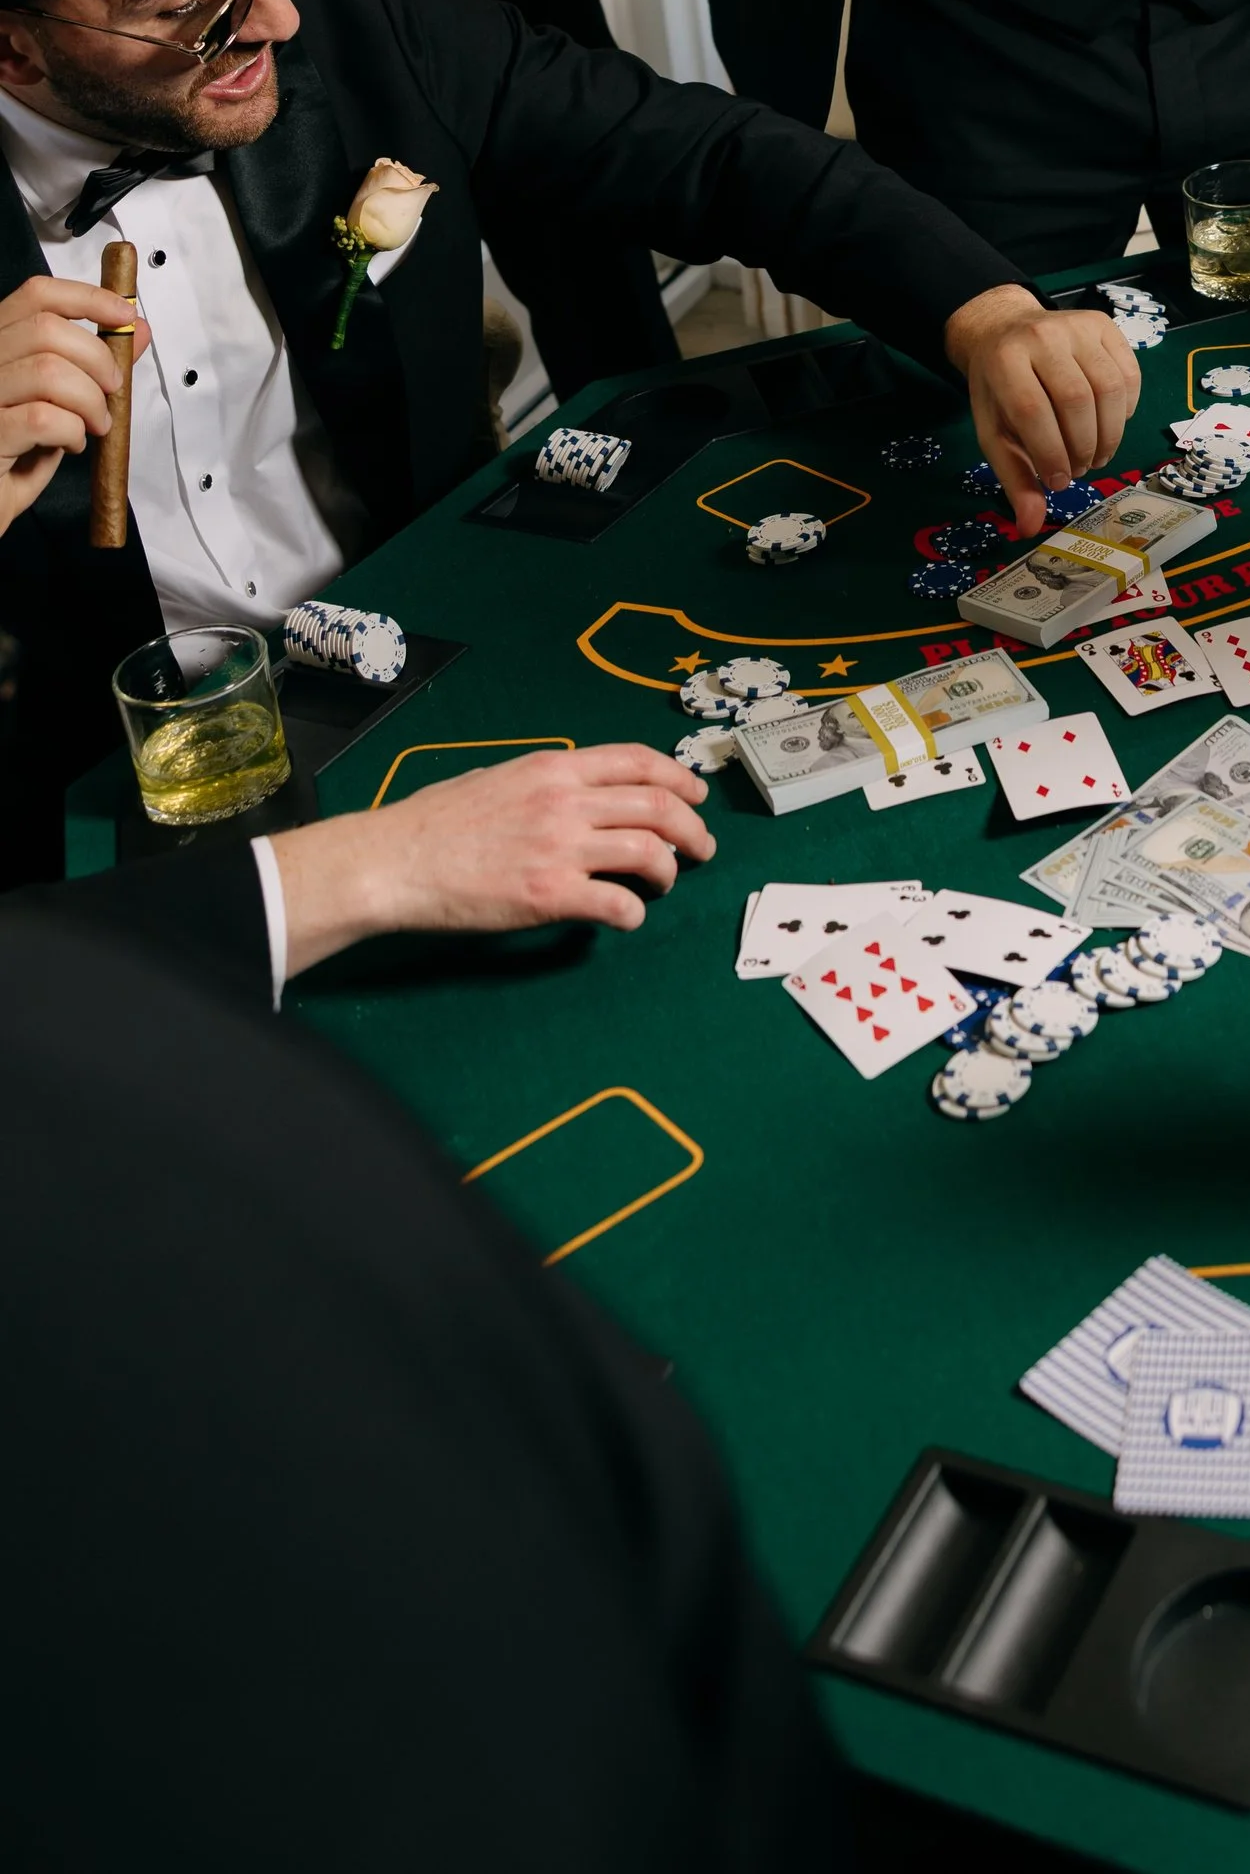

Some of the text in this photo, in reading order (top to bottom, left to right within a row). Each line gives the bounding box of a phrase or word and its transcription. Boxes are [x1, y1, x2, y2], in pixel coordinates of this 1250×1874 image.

[1073, 538, 1115, 557] $10,000
[1152, 594, 1166, 603] Q
[1201, 631, 1212, 639] 9
[1081, 643, 1094, 652] Q
[743, 958, 758, 967] 3
